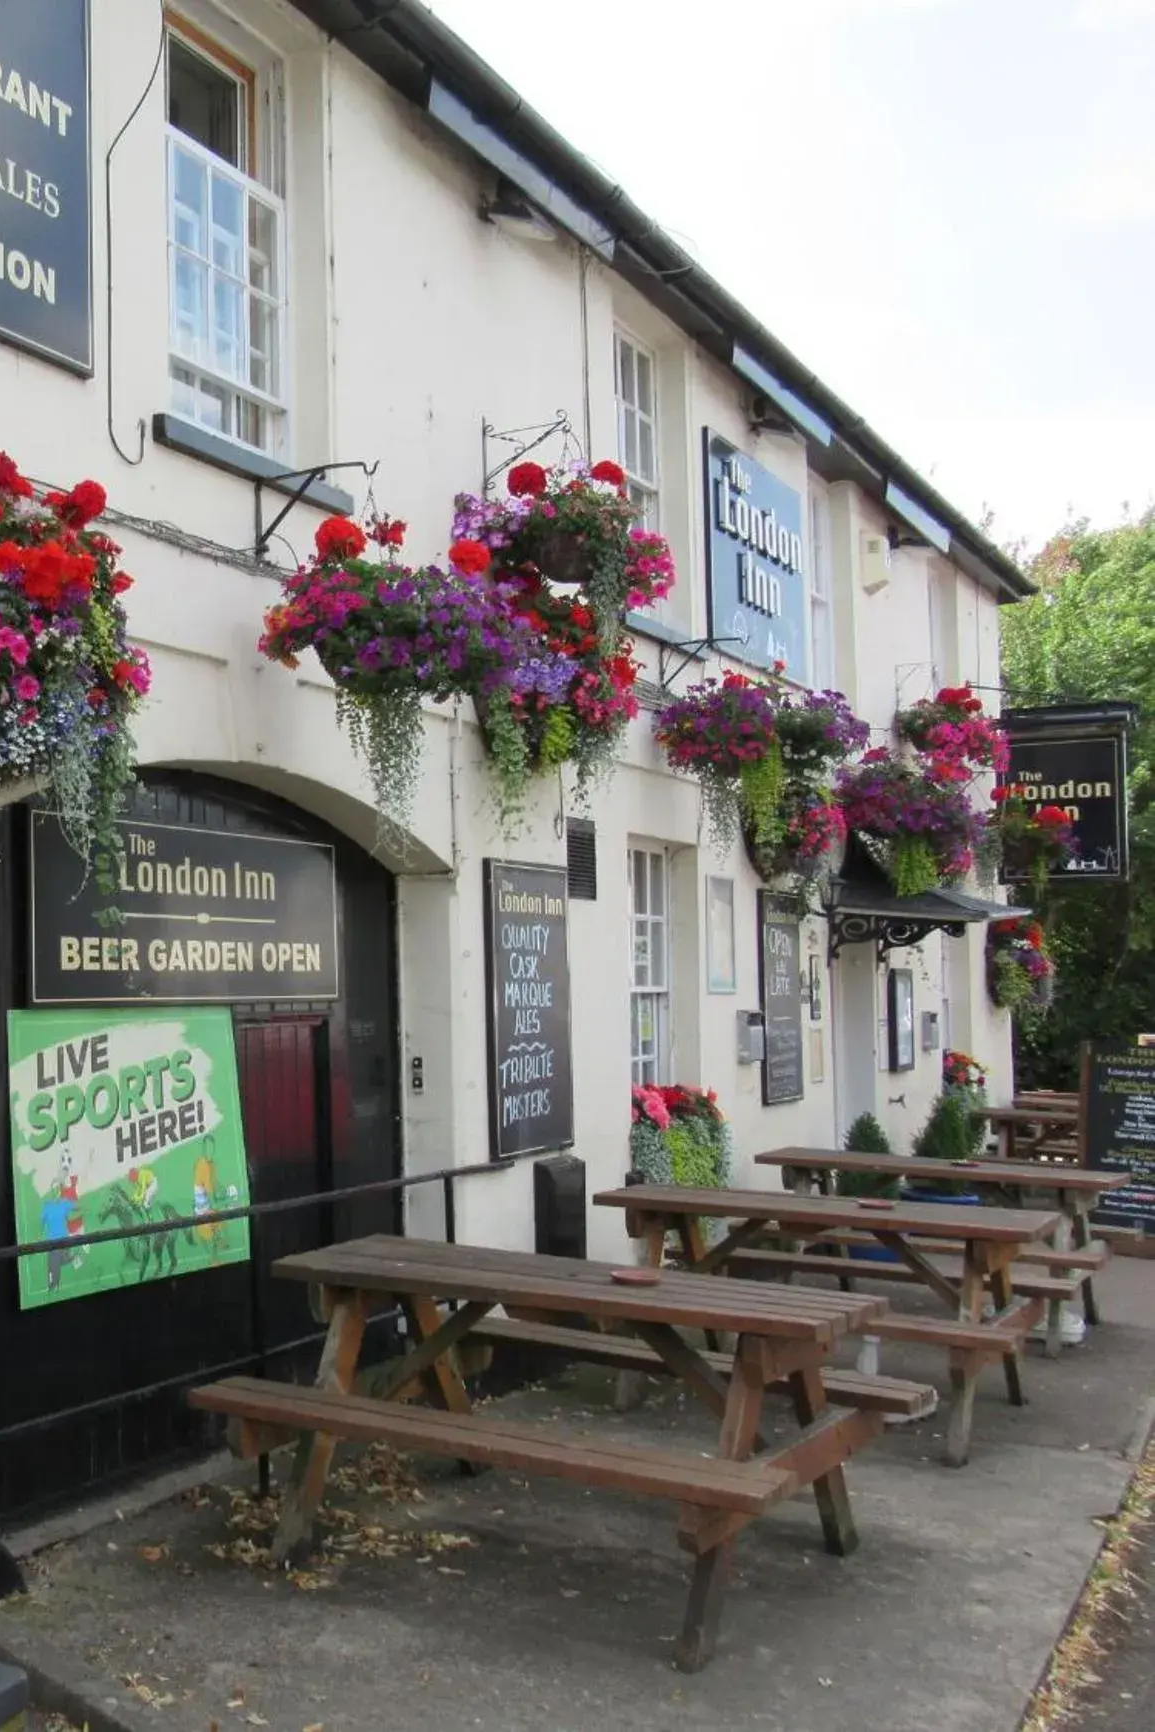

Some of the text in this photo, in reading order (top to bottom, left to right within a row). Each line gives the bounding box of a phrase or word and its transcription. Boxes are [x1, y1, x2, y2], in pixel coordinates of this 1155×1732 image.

[726, 455, 752, 494] The
[718, 476, 803, 574] London
[741, 550, 782, 617] Inn
[1018, 771, 1043, 782] The
[1036, 803, 1080, 822] In
[128, 832, 156, 856] The
[119, 856, 276, 900] London Inn
[498, 889, 563, 916] London Inn
[60, 936, 321, 972] BEER GARDEN OPEN
[502, 923, 550, 955] QUALITY
[509, 952, 540, 980] CASK
[504, 981, 552, 1007] MARQUE
[514, 1009, 541, 1036] ALES
[36, 1033, 109, 1089] LIVE
[498, 1048, 554, 1089] TRIBUTE
[27, 1050, 196, 1152] SPORTS
[503, 1088, 550, 1129] MASTERS
[115, 1100, 206, 1162] HERE!
